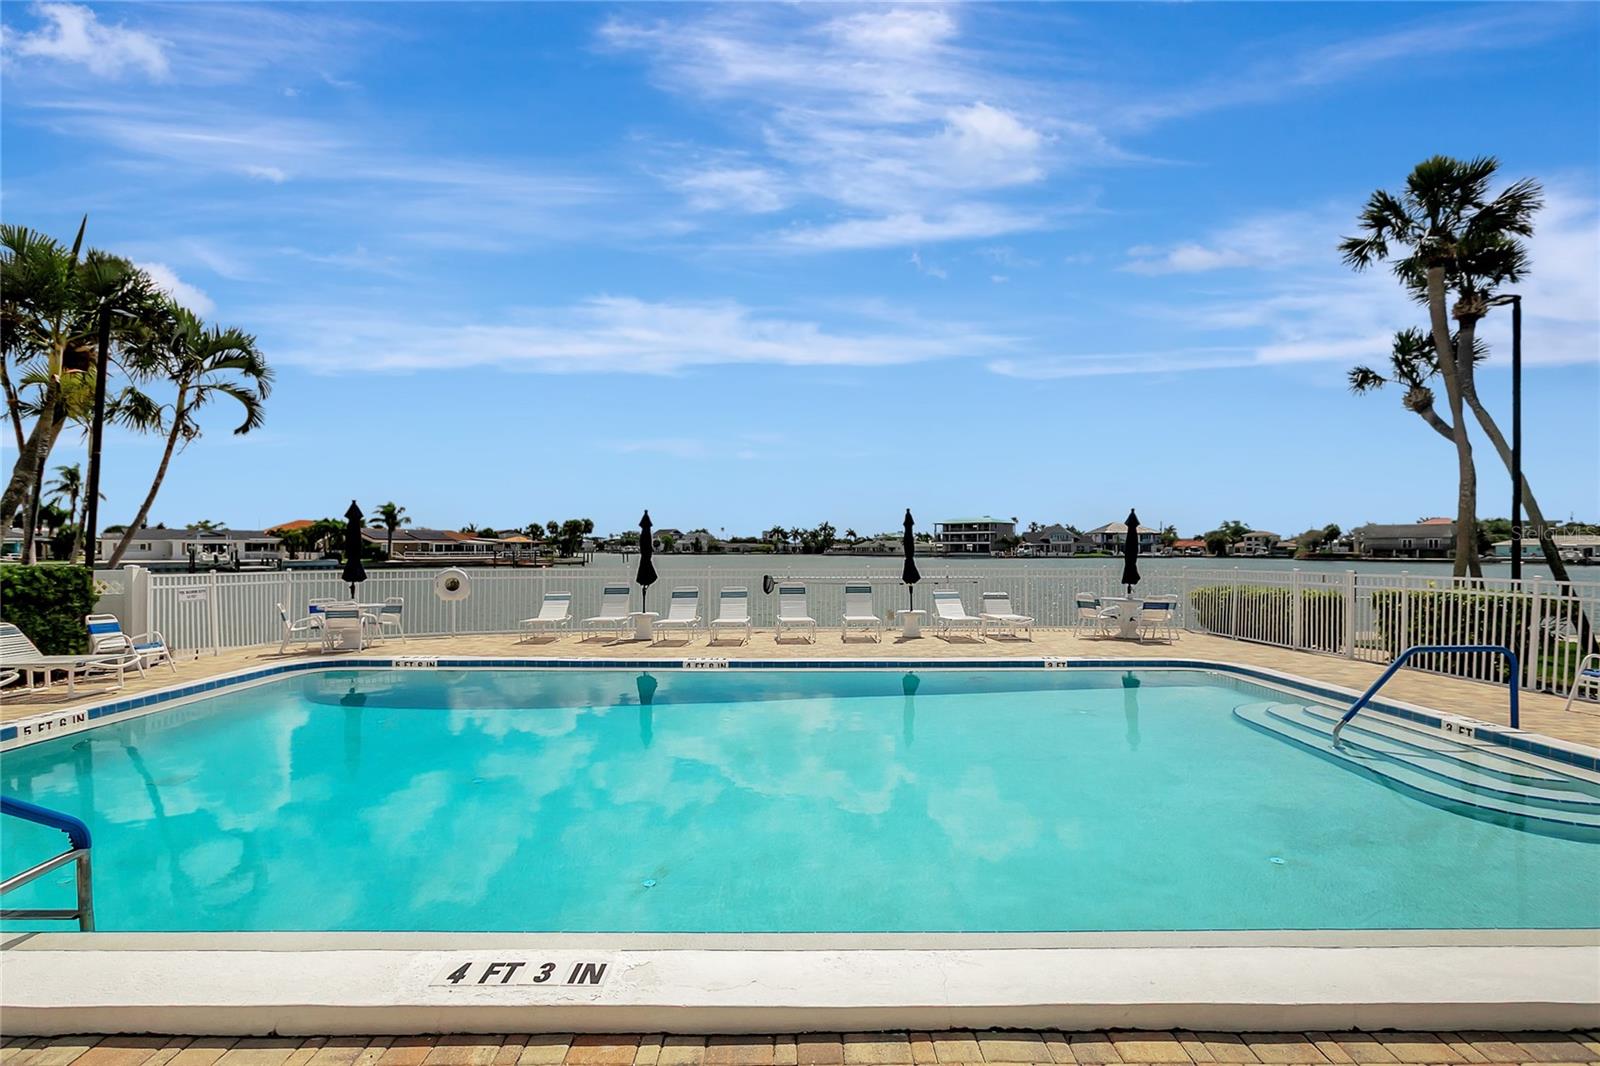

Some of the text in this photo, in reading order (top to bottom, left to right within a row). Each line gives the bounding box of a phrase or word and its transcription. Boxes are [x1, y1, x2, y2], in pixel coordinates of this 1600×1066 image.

[24, 726, 31, 736] 5
[38, 721, 53, 732] FT
[72, 713, 85, 724] IN
[1459, 726, 1473, 737] FT
[446, 962, 607, 984] 4 FT 3 IN
